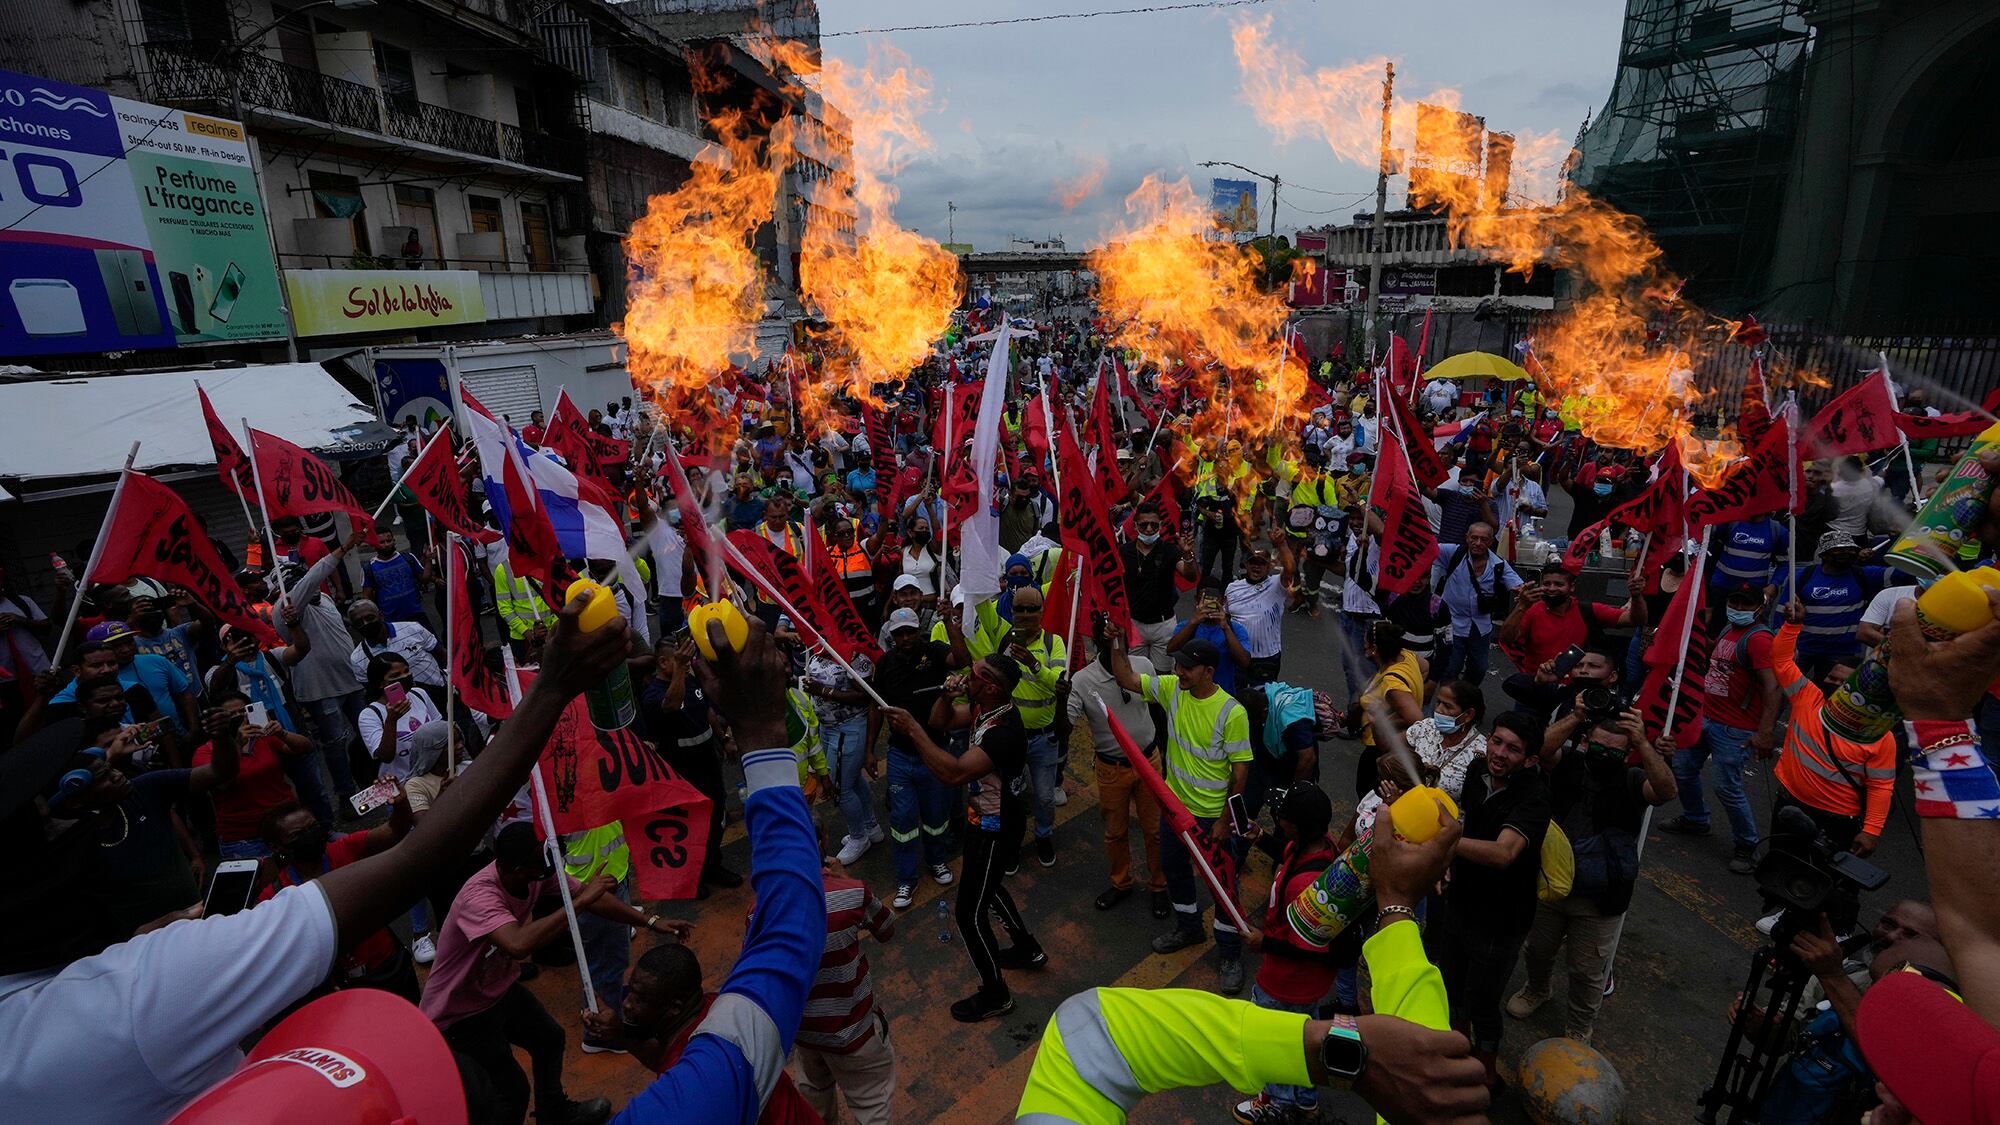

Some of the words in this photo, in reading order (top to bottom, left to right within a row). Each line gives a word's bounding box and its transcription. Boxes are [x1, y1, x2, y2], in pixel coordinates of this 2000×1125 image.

[0, 88, 25, 107] o
[117, 112, 157, 127] realme
[160, 120, 179, 131] C35
[191, 120, 238, 138] realme
[128, 135, 172, 150] Stand-out
[174, 143, 183, 152] 50
[220, 151, 246, 163] Design
[0, 149, 83, 208] O
[156, 166, 237, 194] Perfume
[144, 186, 255, 216] L'fragance
[343, 287, 382, 318] Sol
[383, 286, 400, 315] de
[399, 285, 417, 312] la
[414, 284, 453, 318] India
